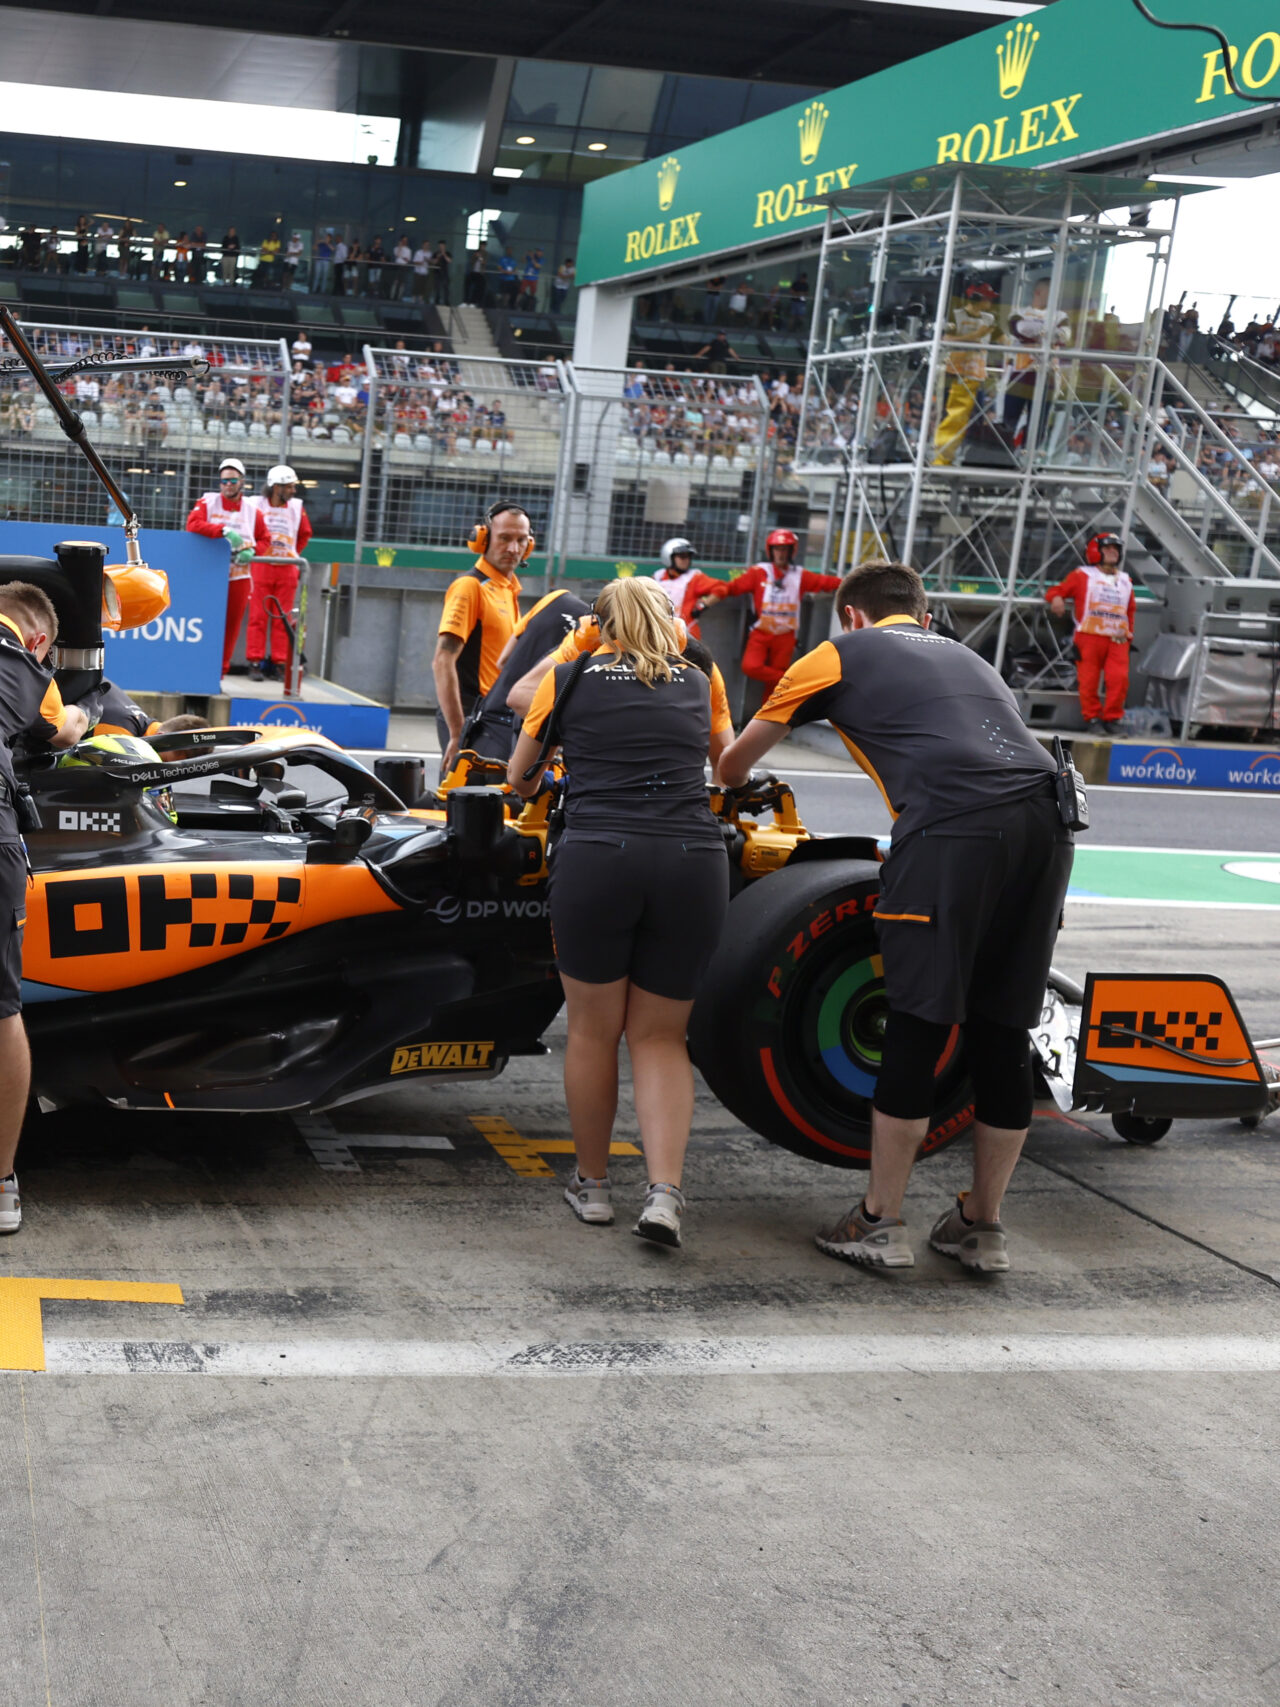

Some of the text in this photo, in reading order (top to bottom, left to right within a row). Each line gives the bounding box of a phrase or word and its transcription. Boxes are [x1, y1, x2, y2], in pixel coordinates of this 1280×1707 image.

[935, 94, 1082, 164] ROLEX
[624, 212, 701, 264] ROLEX
[132, 760, 220, 783] DELL Technologies
[58, 810, 121, 832] OKX
[45, 873, 301, 959] OKX
[466, 901, 551, 918] DP WOR
[1097, 1011, 1223, 1051] OKX
